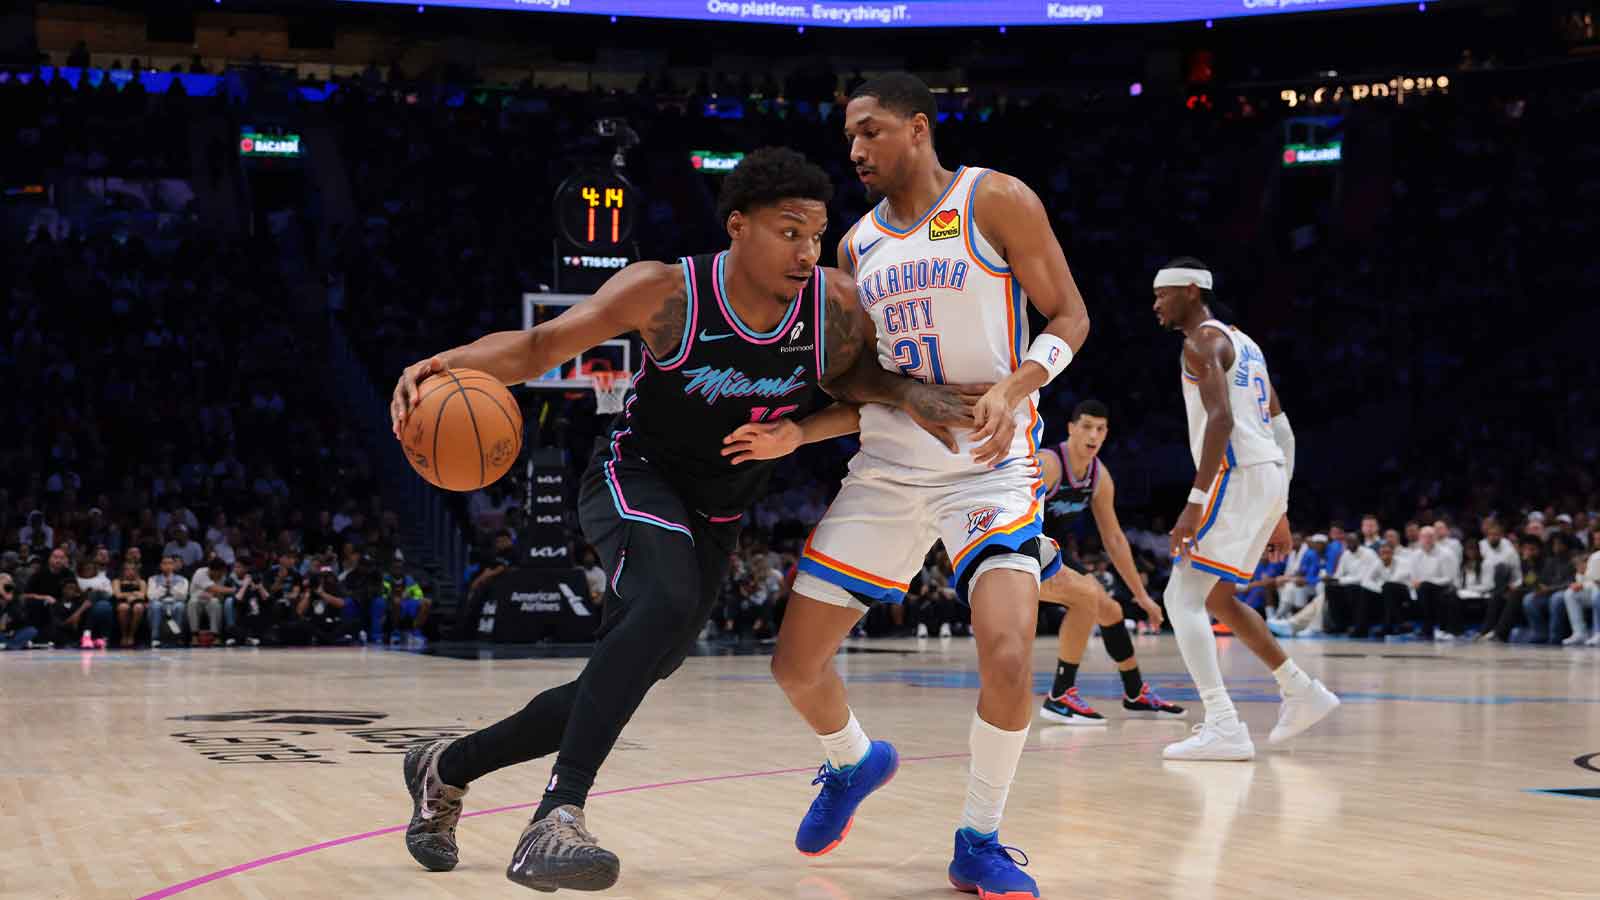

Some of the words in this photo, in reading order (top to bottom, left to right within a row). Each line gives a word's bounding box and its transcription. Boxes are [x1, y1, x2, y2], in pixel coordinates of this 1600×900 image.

[707, 0, 739, 14] One
[740, 1, 809, 18] platform.
[812, 4, 891, 23] Everything
[1047, 3, 1104, 21] Kaseya
[582, 187, 623, 208] 4:14
[587, 207, 620, 242] 11
[580, 255, 628, 268] TISSOT
[857, 257, 969, 312] KLAHOMA
[883, 296, 934, 335] CITY
[780, 343, 814, 353] Robinhood
[892, 334, 947, 385] 21
[682, 365, 807, 405] Miami
[511, 591, 561, 601] American
[520, 602, 561, 612] Airlines
